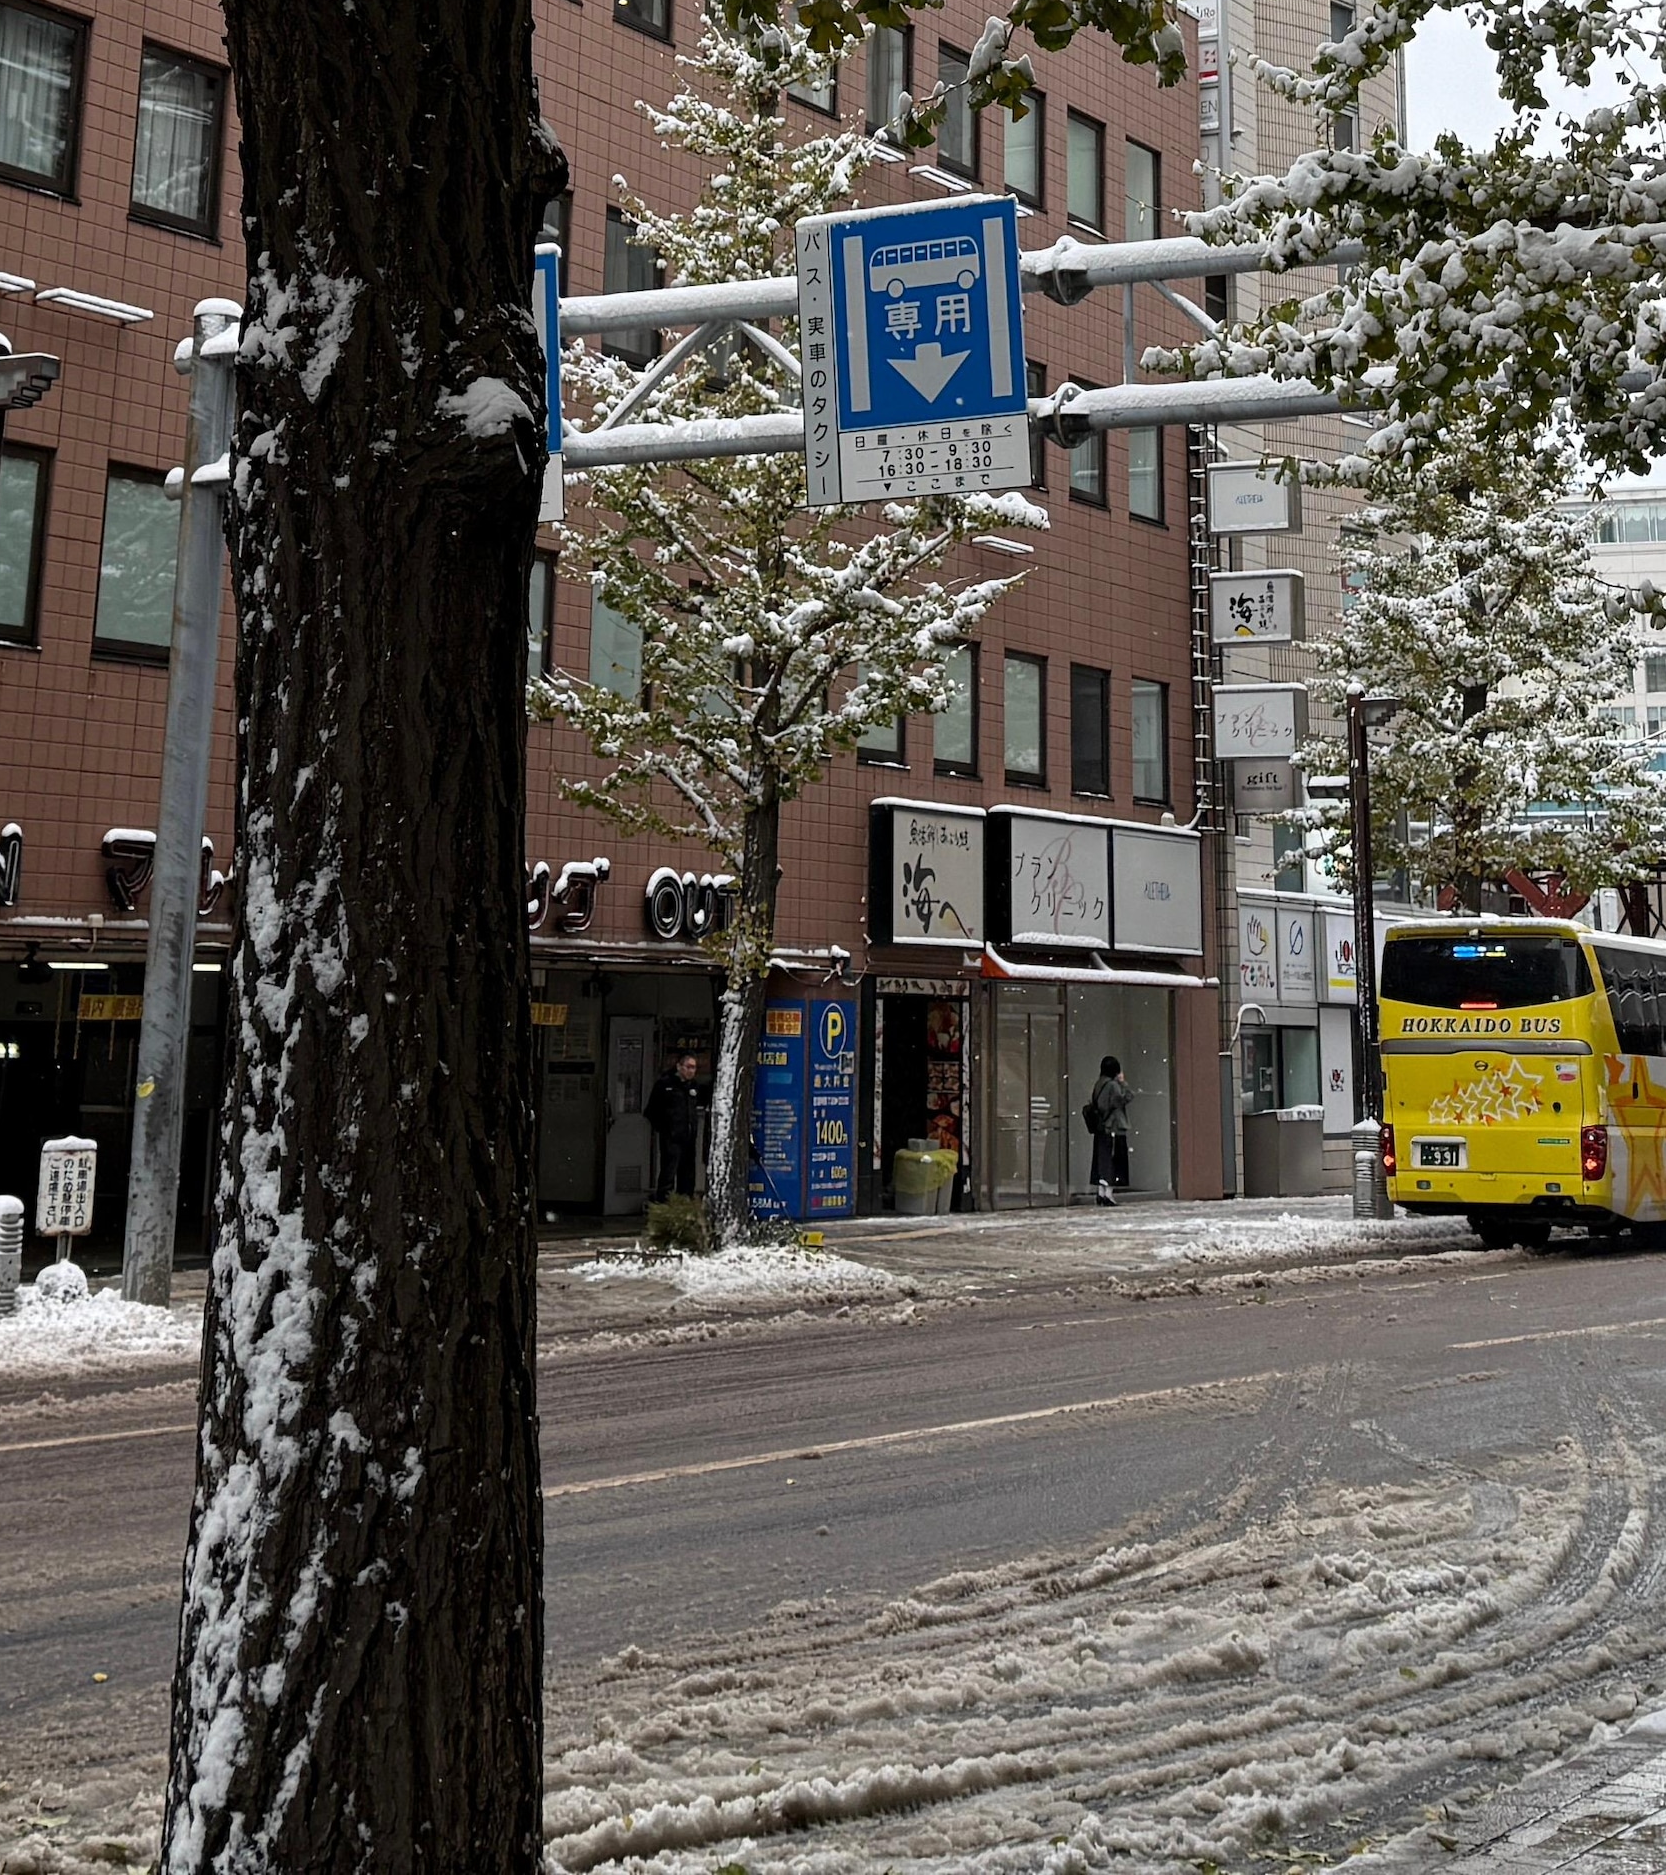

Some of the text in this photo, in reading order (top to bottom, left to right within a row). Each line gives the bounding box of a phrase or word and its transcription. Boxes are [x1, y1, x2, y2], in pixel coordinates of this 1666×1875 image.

[884, 292, 974, 341] 専用
[804, 231, 830, 496] バス・実車のタクシー
[906, 474, 991, 492] ここまで
[1246, 772, 1278, 785] gift
[827, 1012, 842, 1051] P
[1401, 1017, 1562, 1034] HOKKAIDO BUS
